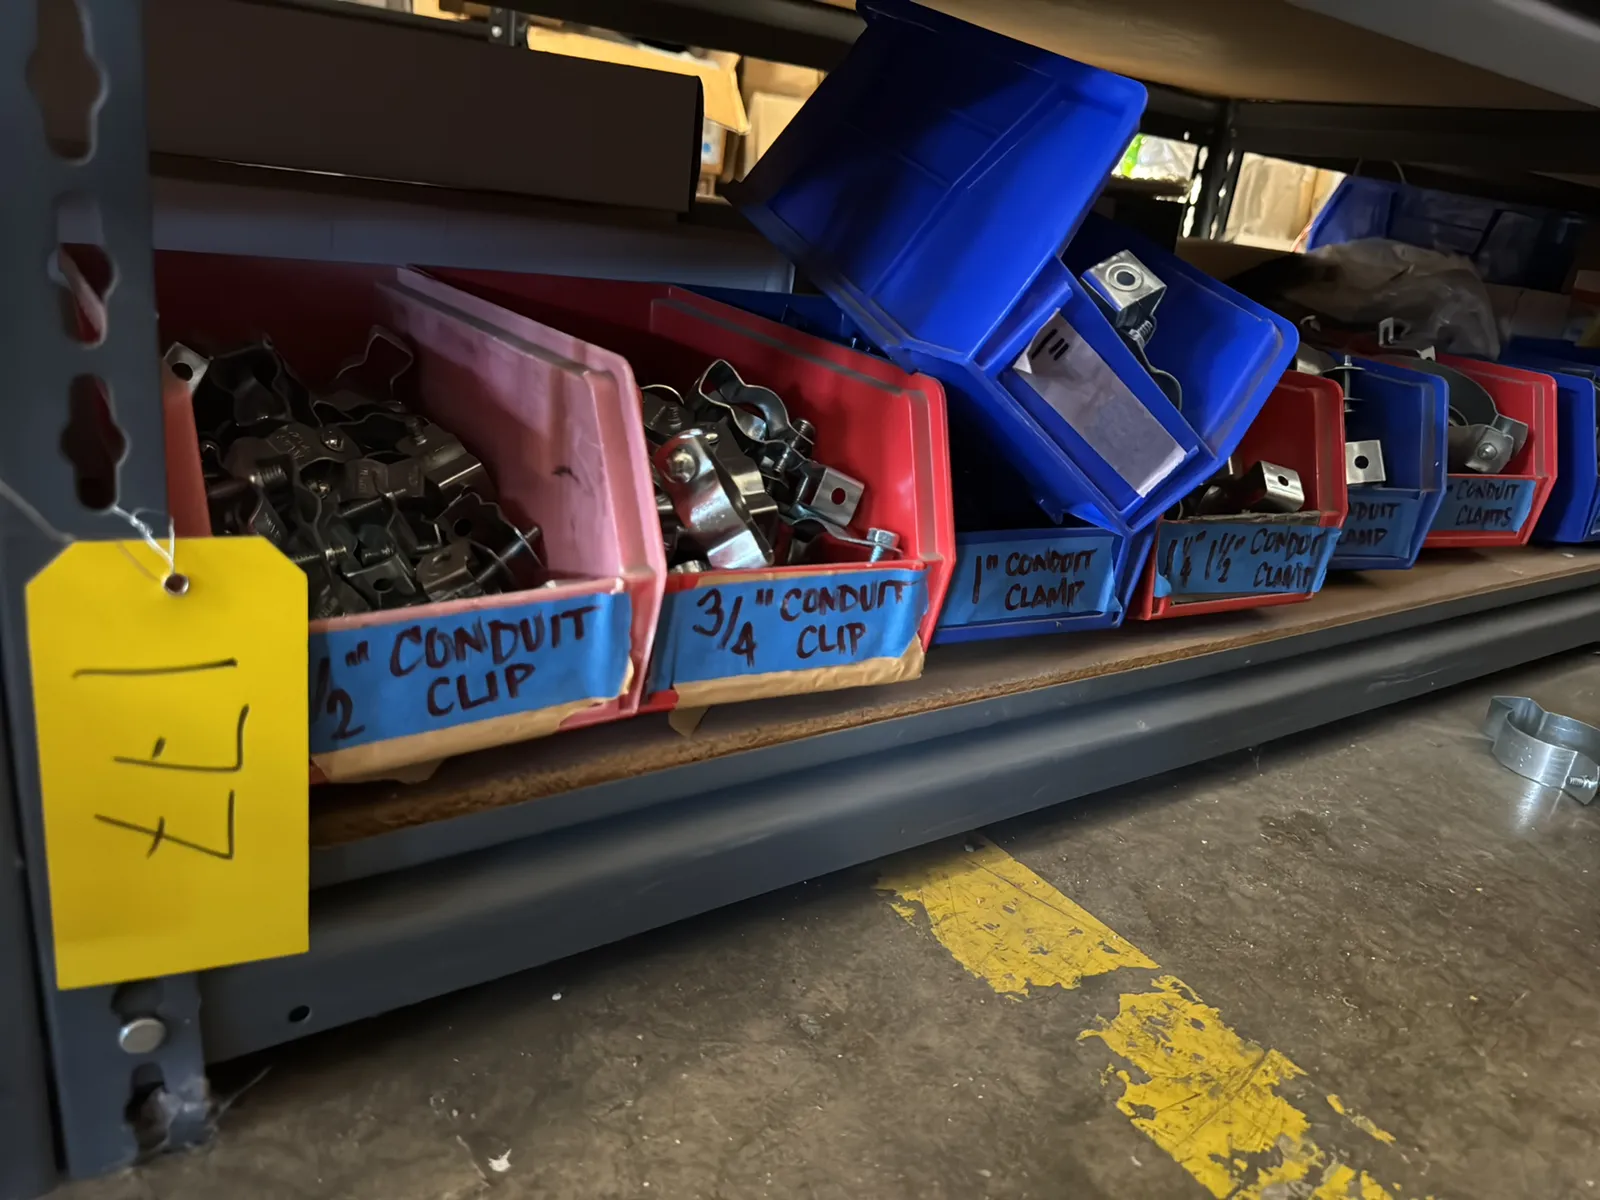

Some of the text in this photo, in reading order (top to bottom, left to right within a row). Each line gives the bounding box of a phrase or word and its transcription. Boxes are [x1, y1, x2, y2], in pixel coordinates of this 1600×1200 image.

[1456, 479, 1520, 500] CONDUIT
[1346, 501, 1401, 520] DUIT
[1005, 547, 1097, 577] CONDUIT
[779, 579, 918, 622] CONDUIT
[1005, 577, 1085, 611] CLAMP
[389, 605, 602, 677] CONDUIT
[796, 622, 866, 659] CLIP
[427, 663, 536, 717] CLIP
